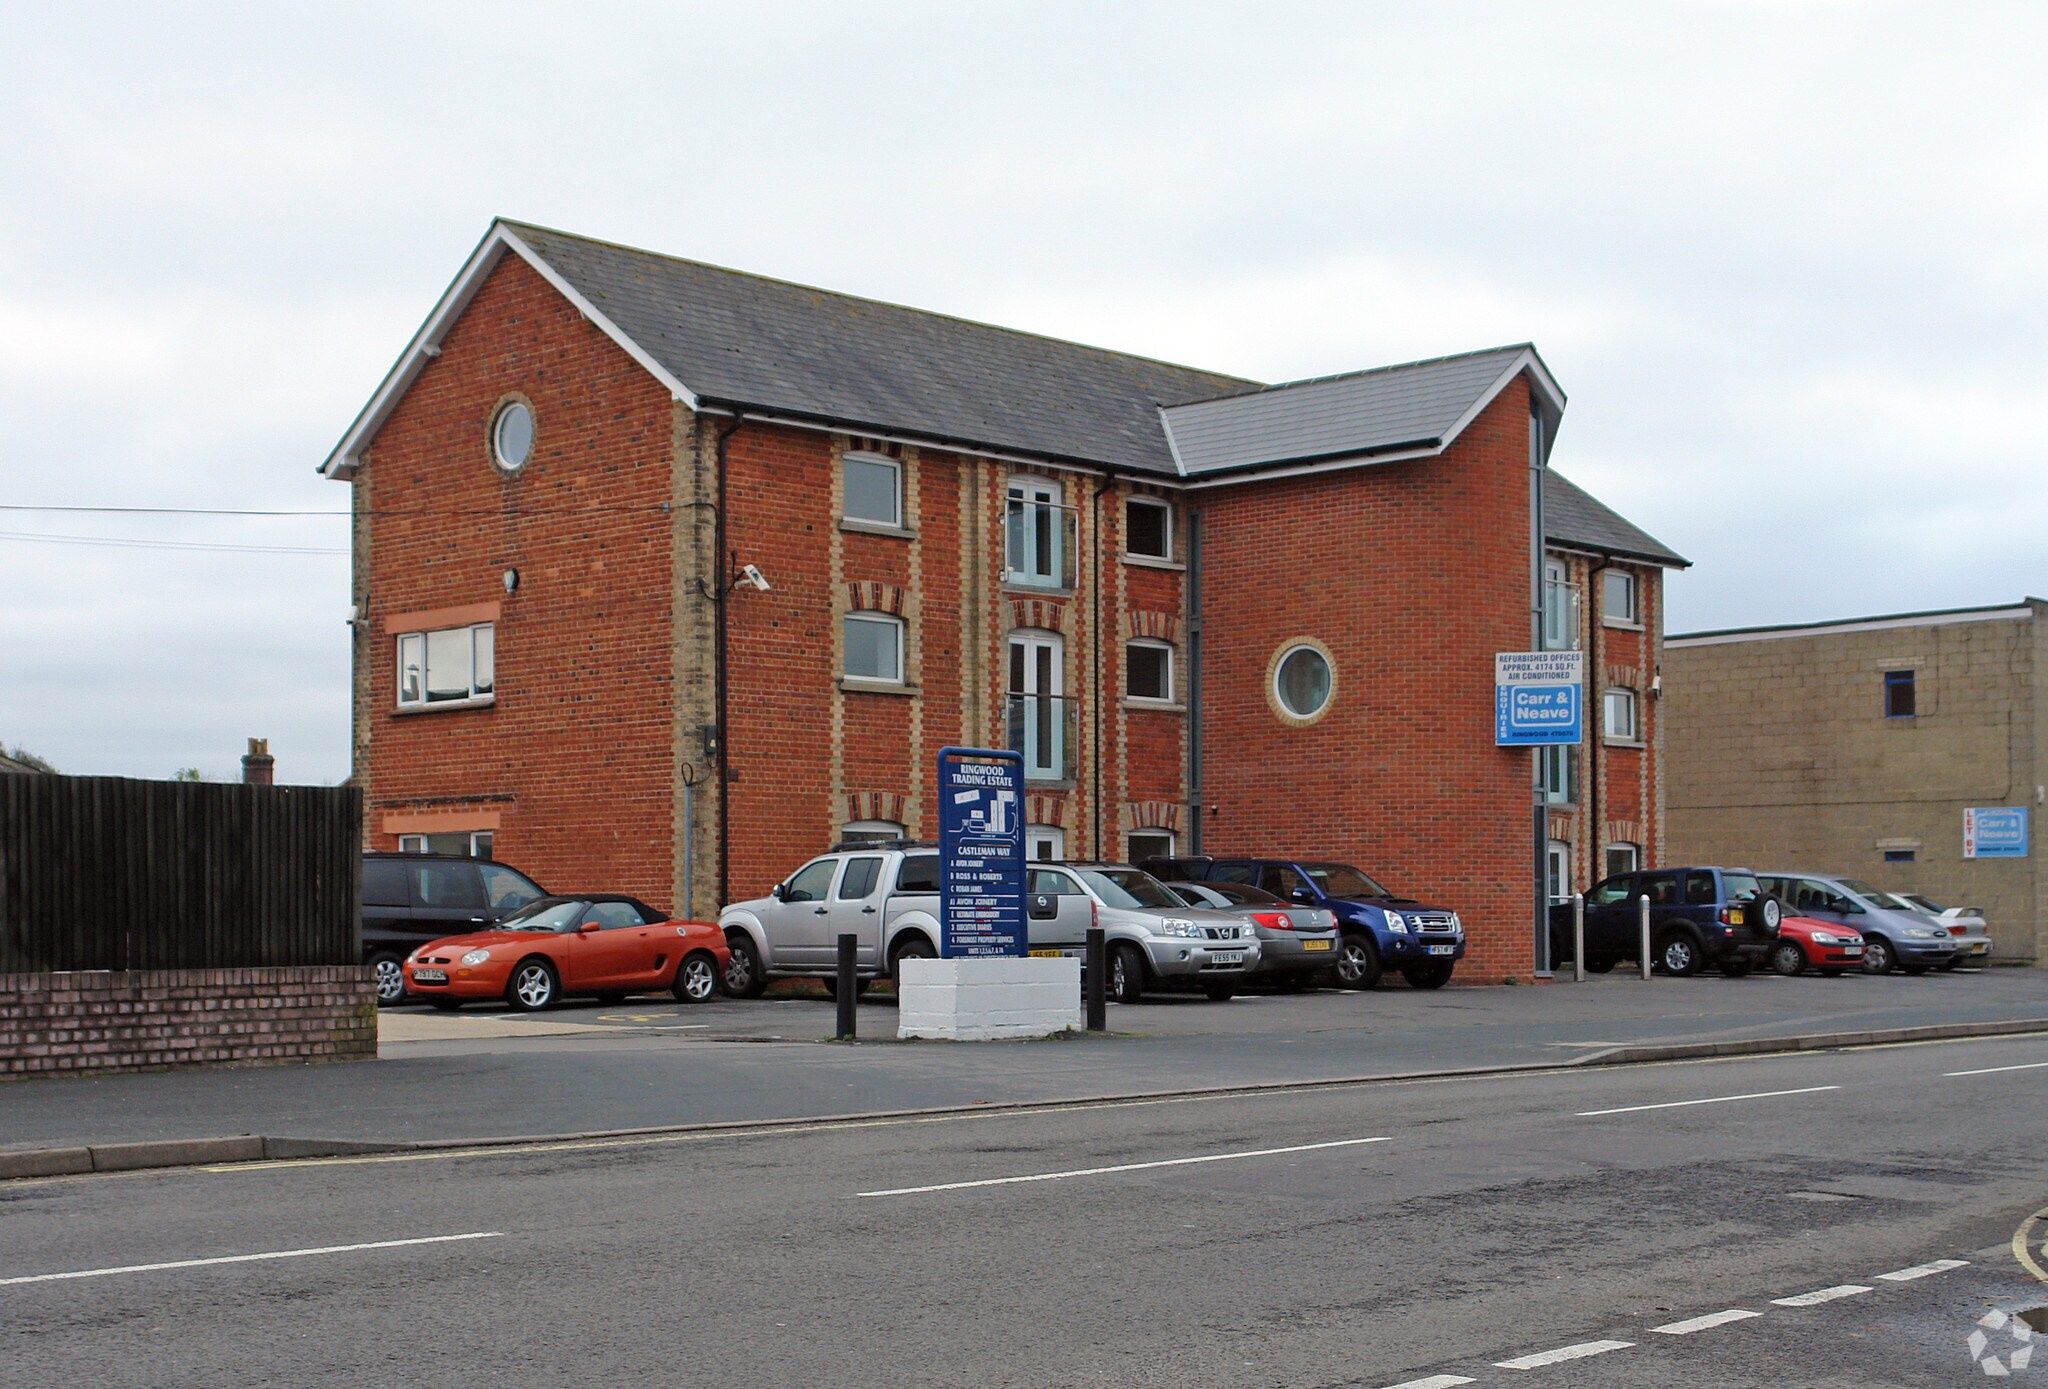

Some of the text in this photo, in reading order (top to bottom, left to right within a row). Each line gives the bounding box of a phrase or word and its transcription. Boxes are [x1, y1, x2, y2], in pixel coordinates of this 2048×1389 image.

[1517, 692, 1568, 704] Carr &
[1517, 707, 1569, 719] Neave
[961, 764, 1004, 776] RINGWOOD
[952, 774, 1013, 787] TRADING ESTATE
[958, 846, 1010, 856] CASTLEMAN WAY
[1967, 839, 1972, 855] BY
